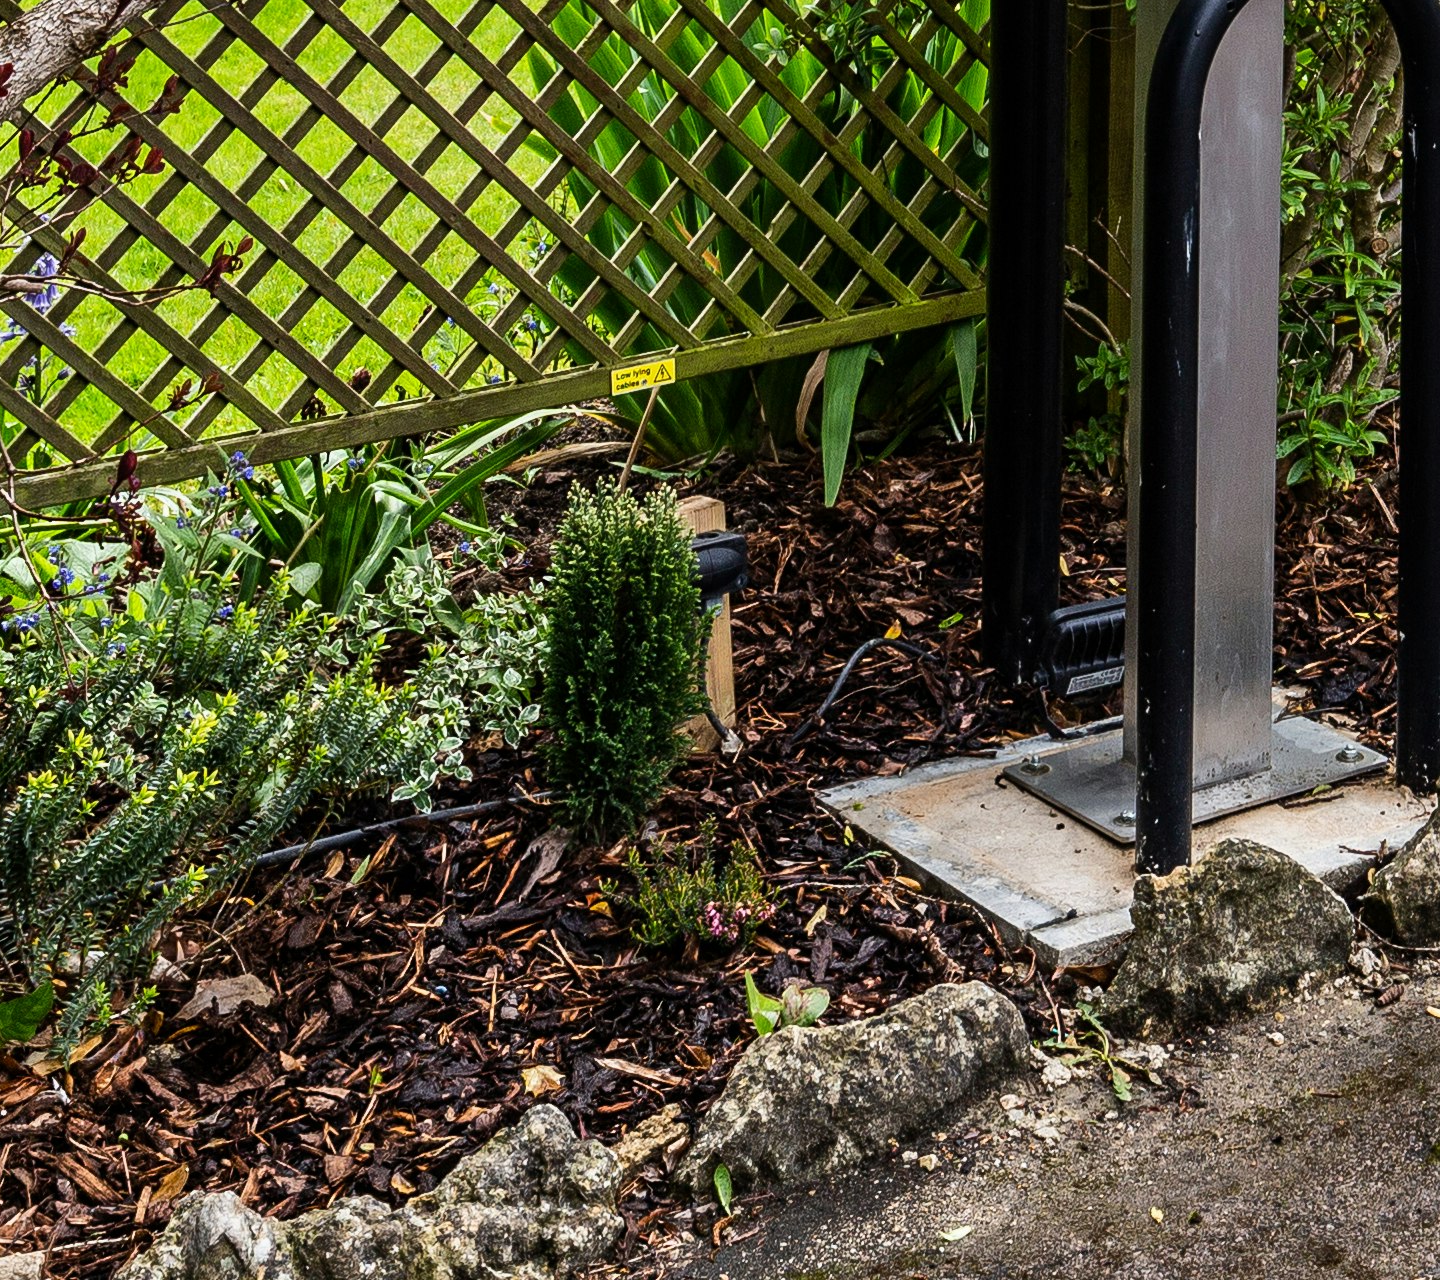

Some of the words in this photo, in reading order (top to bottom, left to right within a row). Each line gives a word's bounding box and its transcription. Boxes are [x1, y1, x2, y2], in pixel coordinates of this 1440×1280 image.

[616, 371, 632, 381] Low
[632, 368, 651, 378] lying
[616, 380, 640, 390] cables
